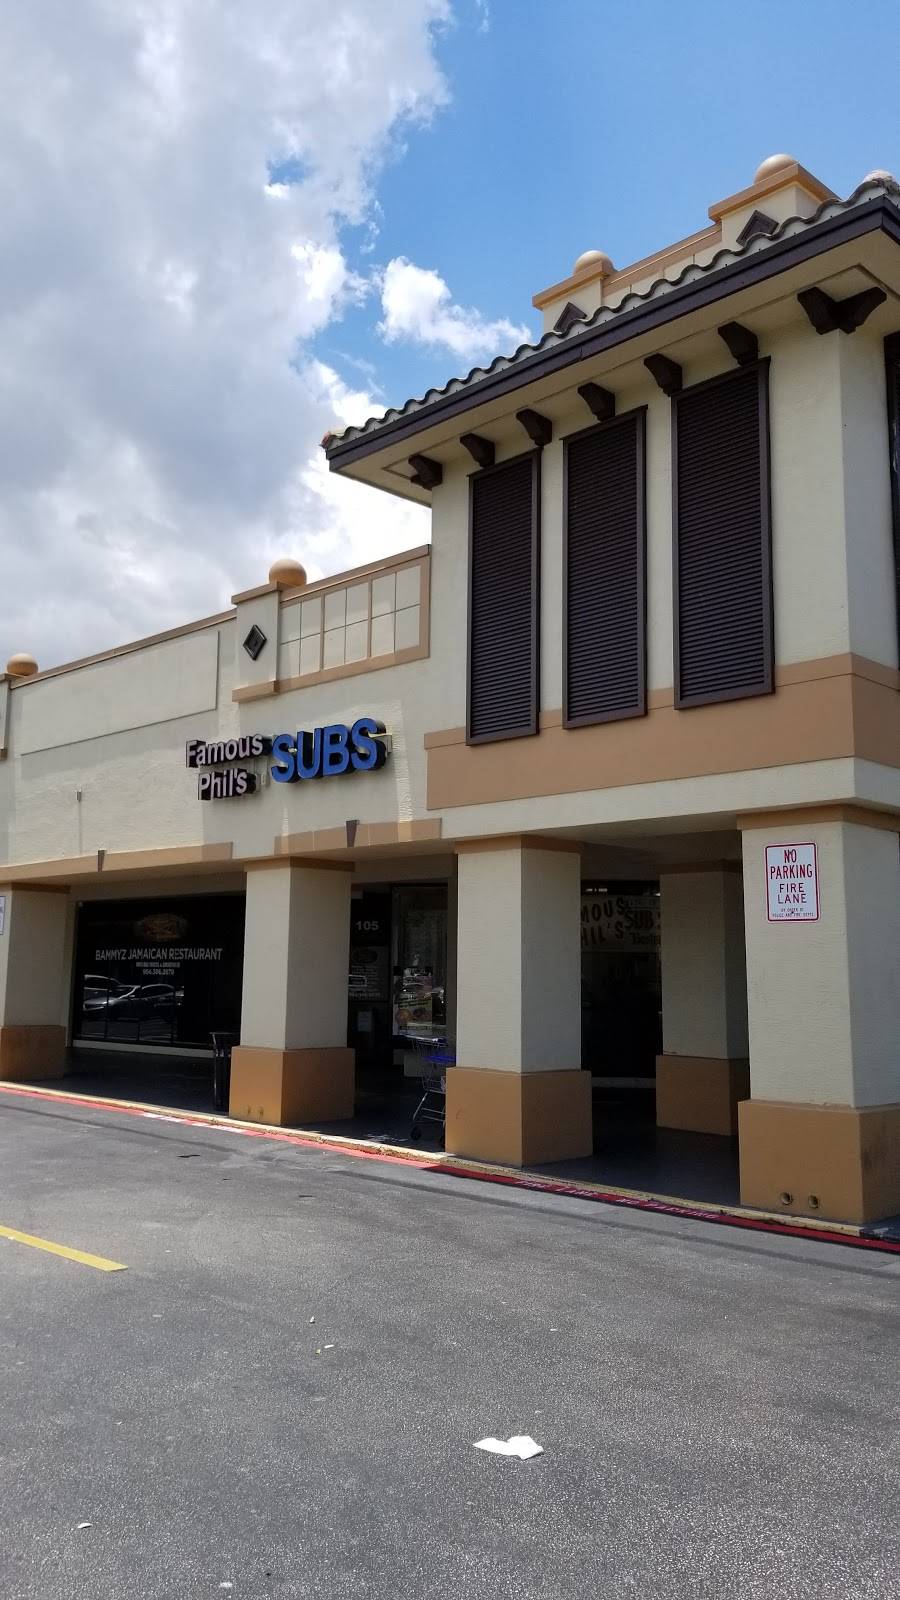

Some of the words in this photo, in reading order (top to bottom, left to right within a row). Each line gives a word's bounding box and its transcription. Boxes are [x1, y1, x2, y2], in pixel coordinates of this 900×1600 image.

[186, 734, 264, 768] Famous
[271, 718, 384, 783] SUBS
[198, 767, 248, 800] Phil's
[783, 849, 797, 864] NO
[770, 863, 813, 880] PARKING
[779, 882, 805, 894] FIRE
[778, 893, 807, 904] LANE
[356, 920, 380, 931] 105
[95, 949, 127, 961] BAMMYZ
[128, 948, 168, 960] JAMAICAN
[169, 947, 223, 961] RESTAURANT
[644, 1203, 720, 1219] PARKING
